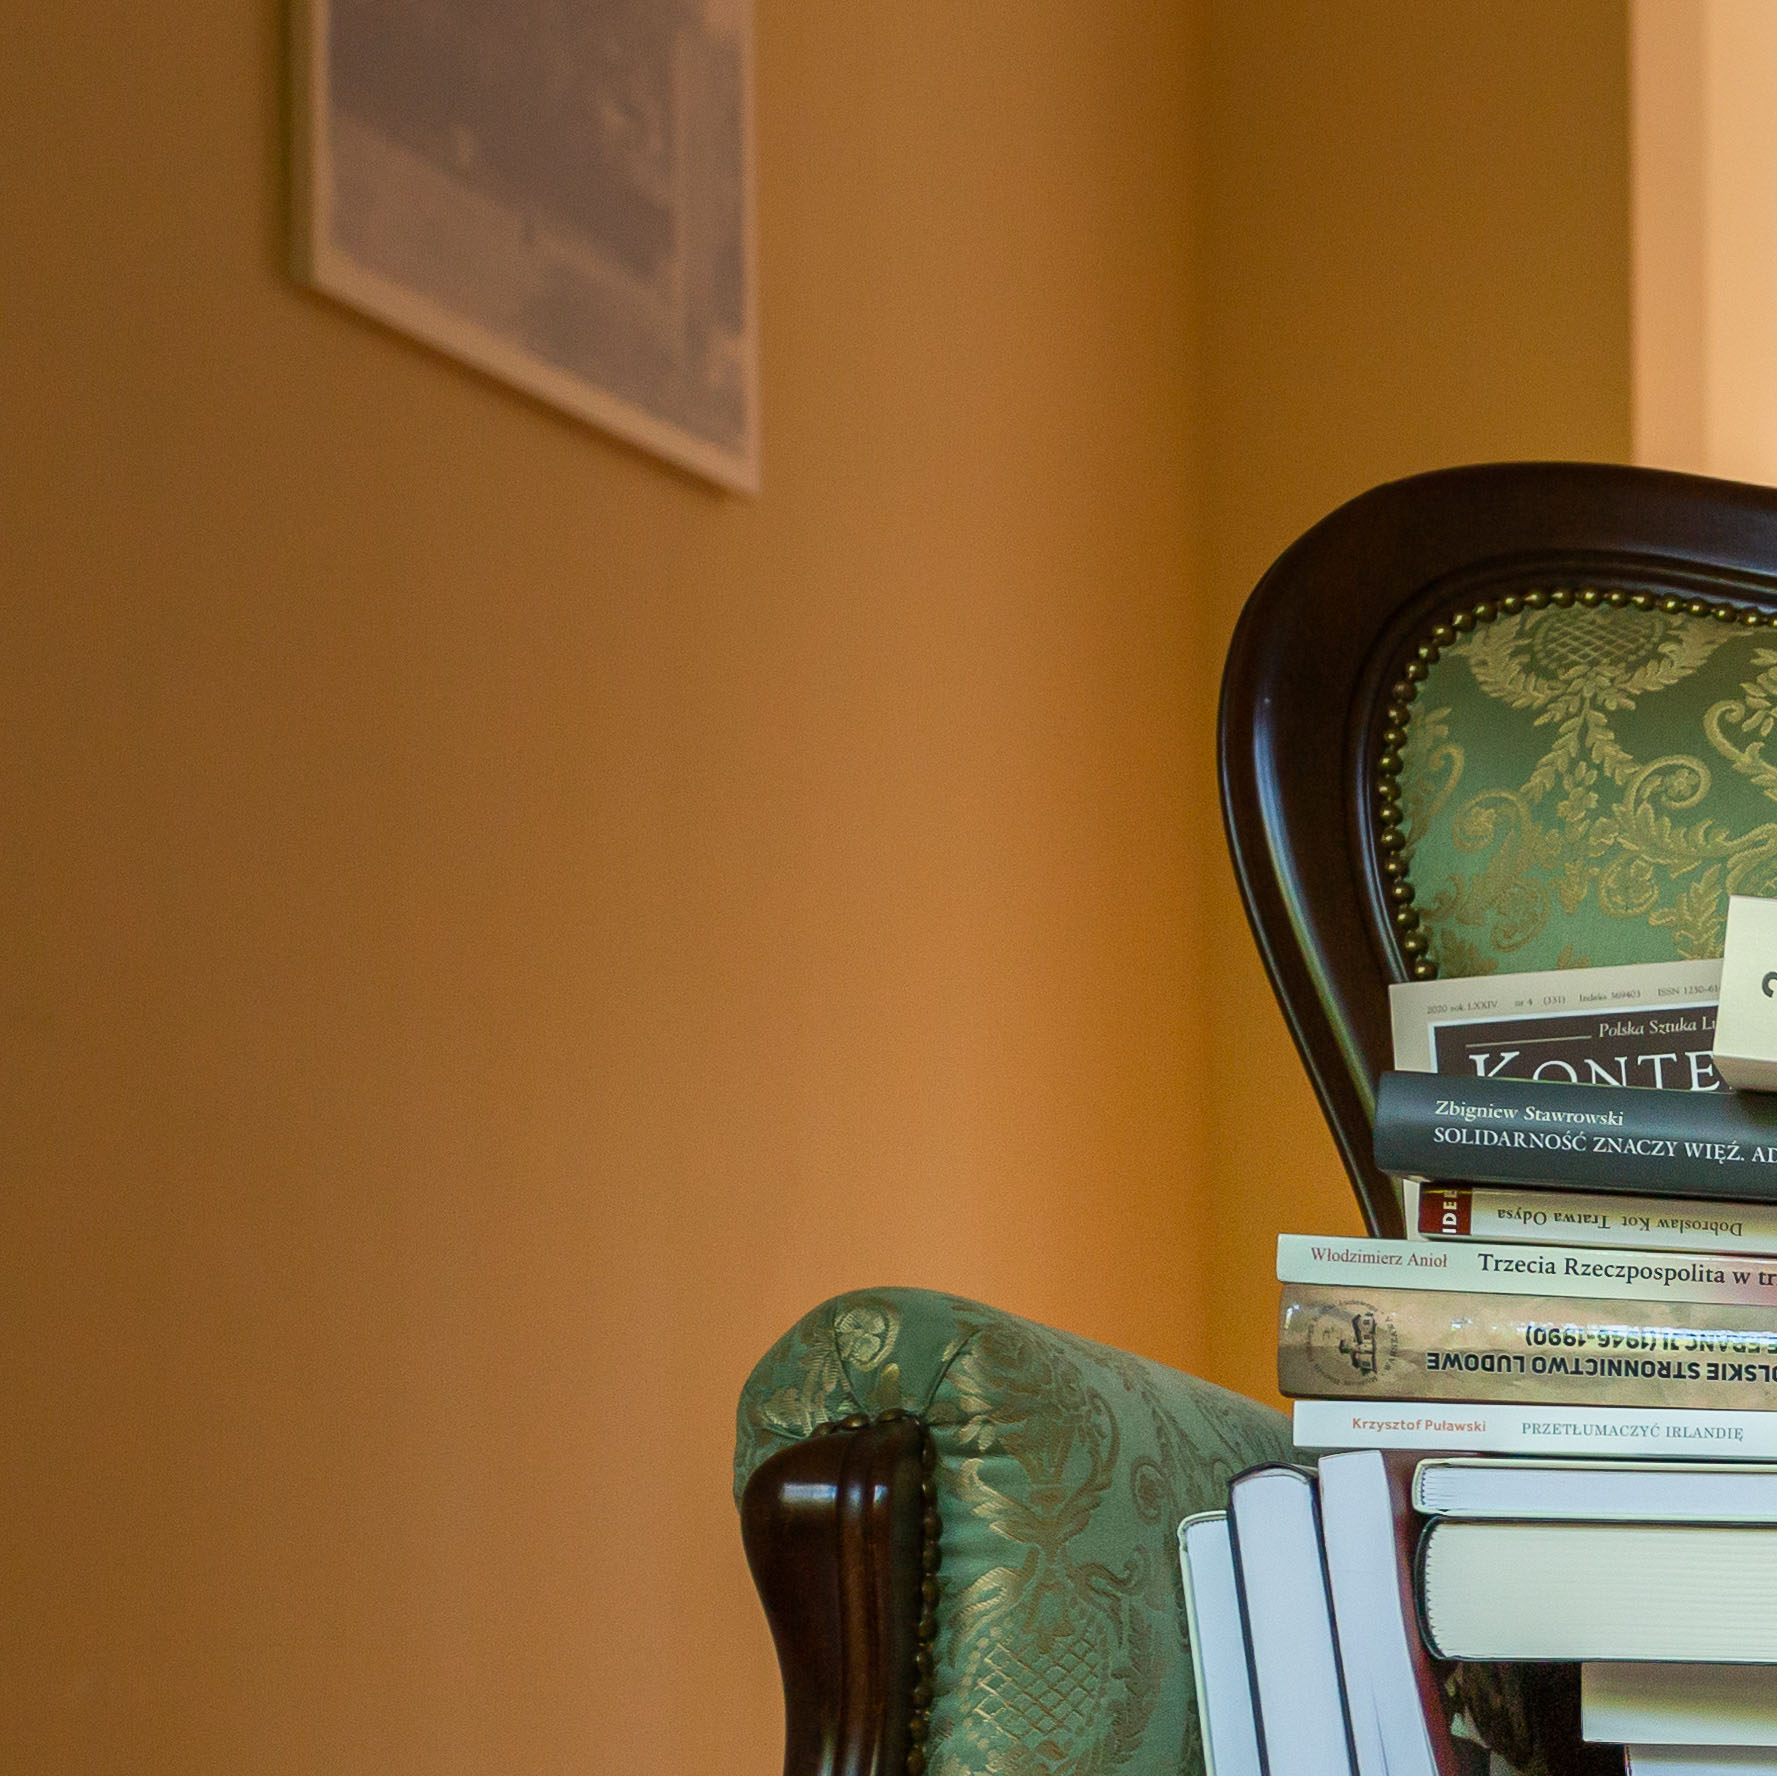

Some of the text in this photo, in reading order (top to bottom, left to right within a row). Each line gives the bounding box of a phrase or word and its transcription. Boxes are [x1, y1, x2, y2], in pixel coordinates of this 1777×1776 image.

[1658, 986, 1680, 997] ISSN
[1600, 1021, 1644, 1038] Polska
[1649, 1016, 1696, 1035] Sztuka
[1435, 1099, 1624, 1126] Zbigniew Stawrowski
[1433, 1127, 1587, 1152] SOLIDARNOŚĆ
[1592, 1136, 1678, 1157] ZNACZY
[1684, 1139, 1745, 1165] WIĘŹ.
[1497, 1207, 1547, 1226] Odysa
[1553, 1212, 1611, 1229] Tratwa
[1622, 1215, 1650, 1231] Kot
[1310, 1246, 1448, 1268] Włodzimierz Anioł
[1478, 1252, 1556, 1276] Trzecia
[1564, 1256, 1725, 1288] Rzeczpospolita
[1732, 1272, 1751, 1285] w
[1426, 1352, 1526, 1373] LUDOWE
[1531, 1356, 1701, 1379] STRONNICTWO
[1352, 1417, 1486, 1433] Krzysztof Puławski
[1521, 1418, 1744, 1441] PRZETŁUMACZYĆ IRLANDIĘ
